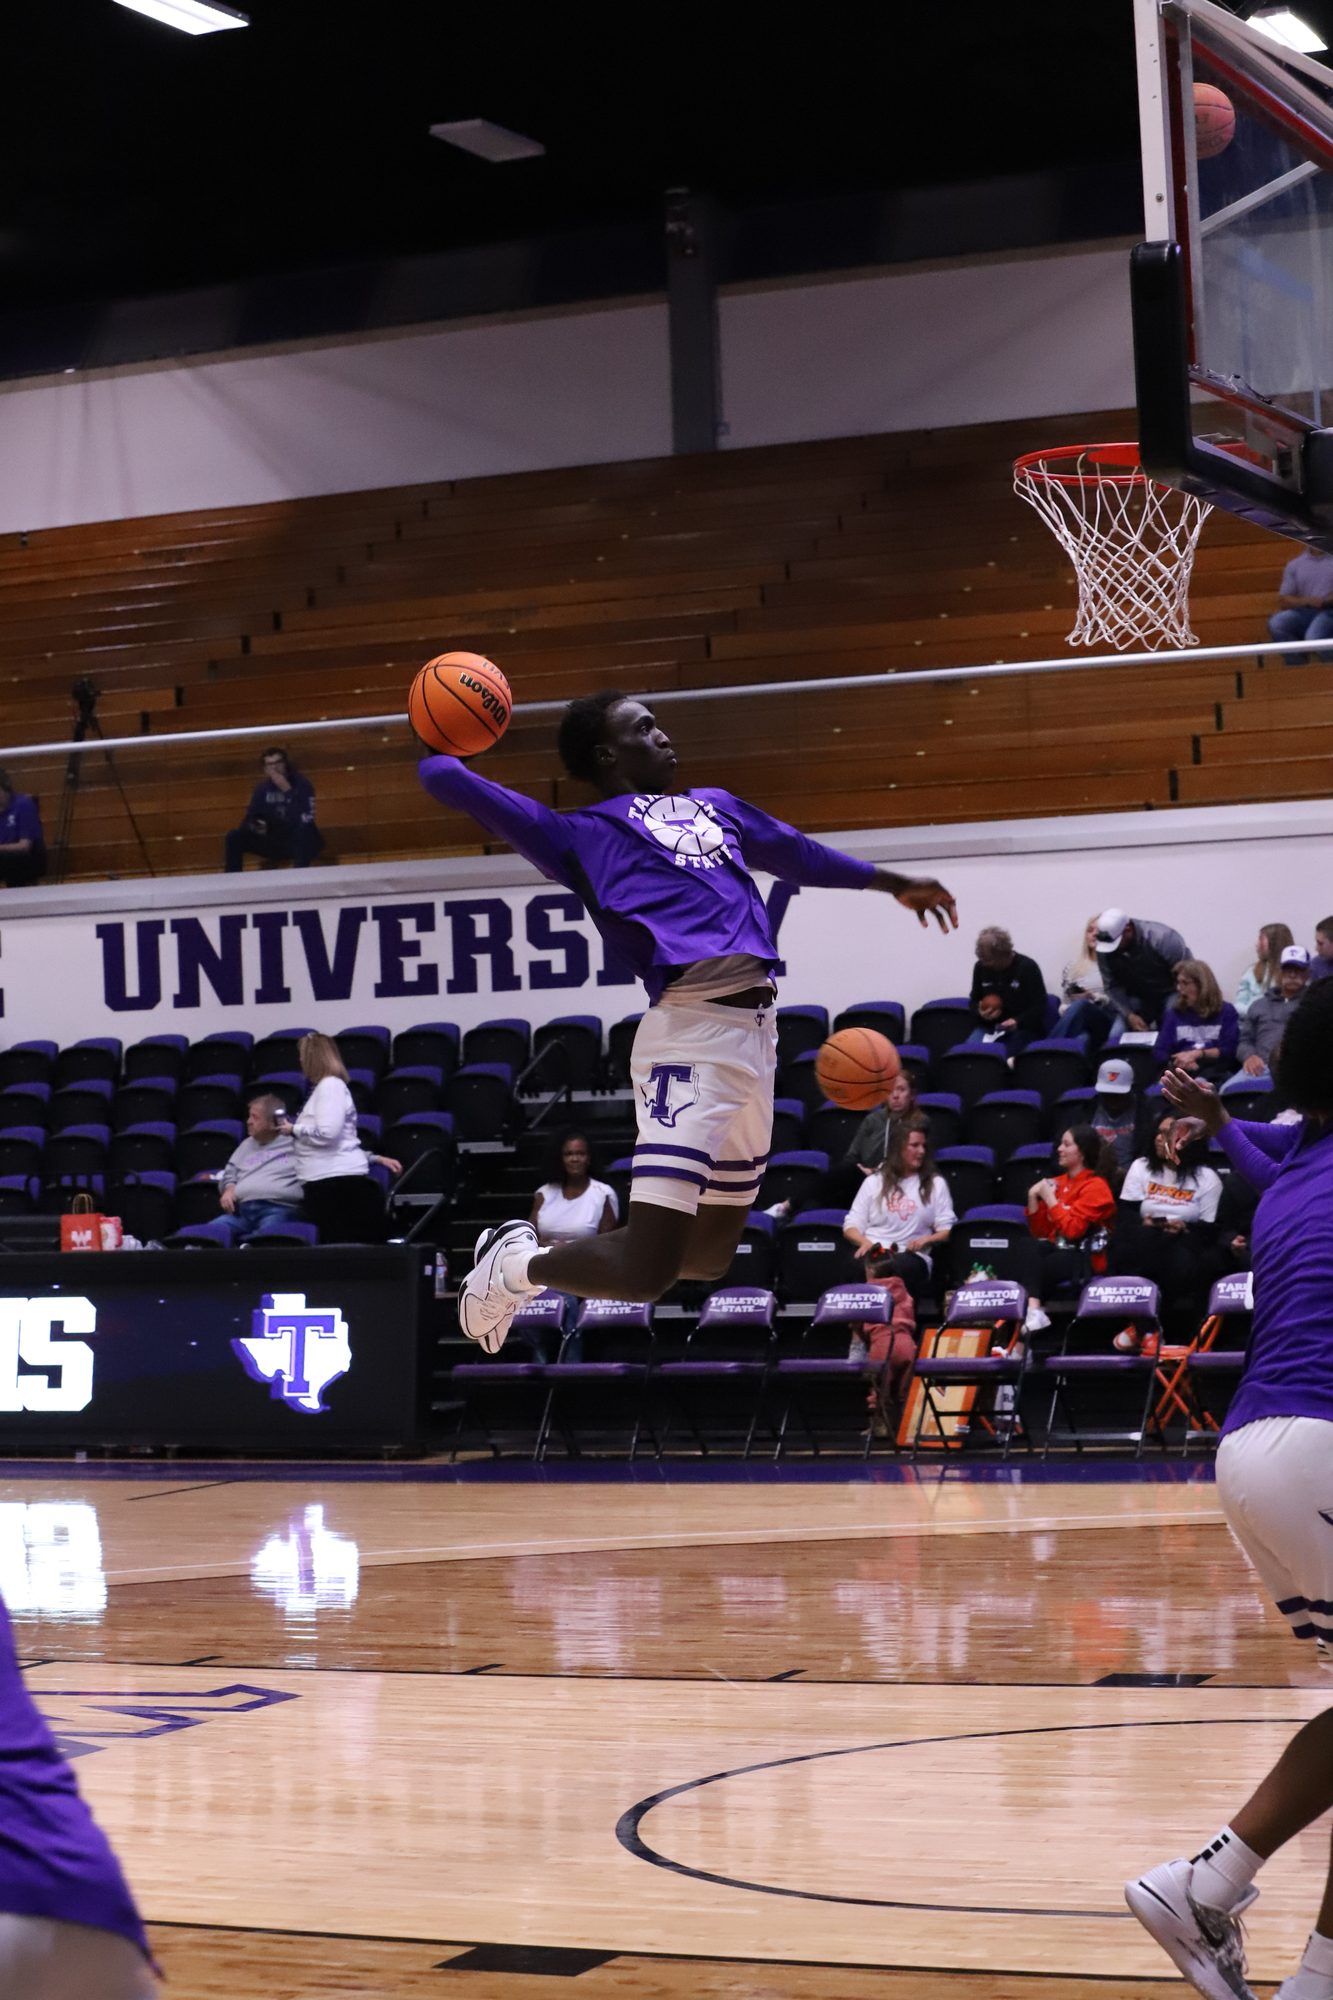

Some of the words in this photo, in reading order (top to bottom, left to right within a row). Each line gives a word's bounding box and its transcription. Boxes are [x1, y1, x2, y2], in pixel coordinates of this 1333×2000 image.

[459, 672, 507, 727] Wilson
[96, 880, 800, 1012] UNIVERS
[957, 1290, 1020, 1300] TARLETON
[1088, 1286, 1152, 1297] TARLETON
[710, 1297, 769, 1307] TARLETON
[825, 1293, 887, 1304] TARLETON
[969, 1298, 1005, 1307] STATE
[1100, 1295, 1137, 1303] STATE
[597, 1307, 632, 1315] STATE
[721, 1305, 754, 1313] STATE
[264, 1308, 341, 1397] T
